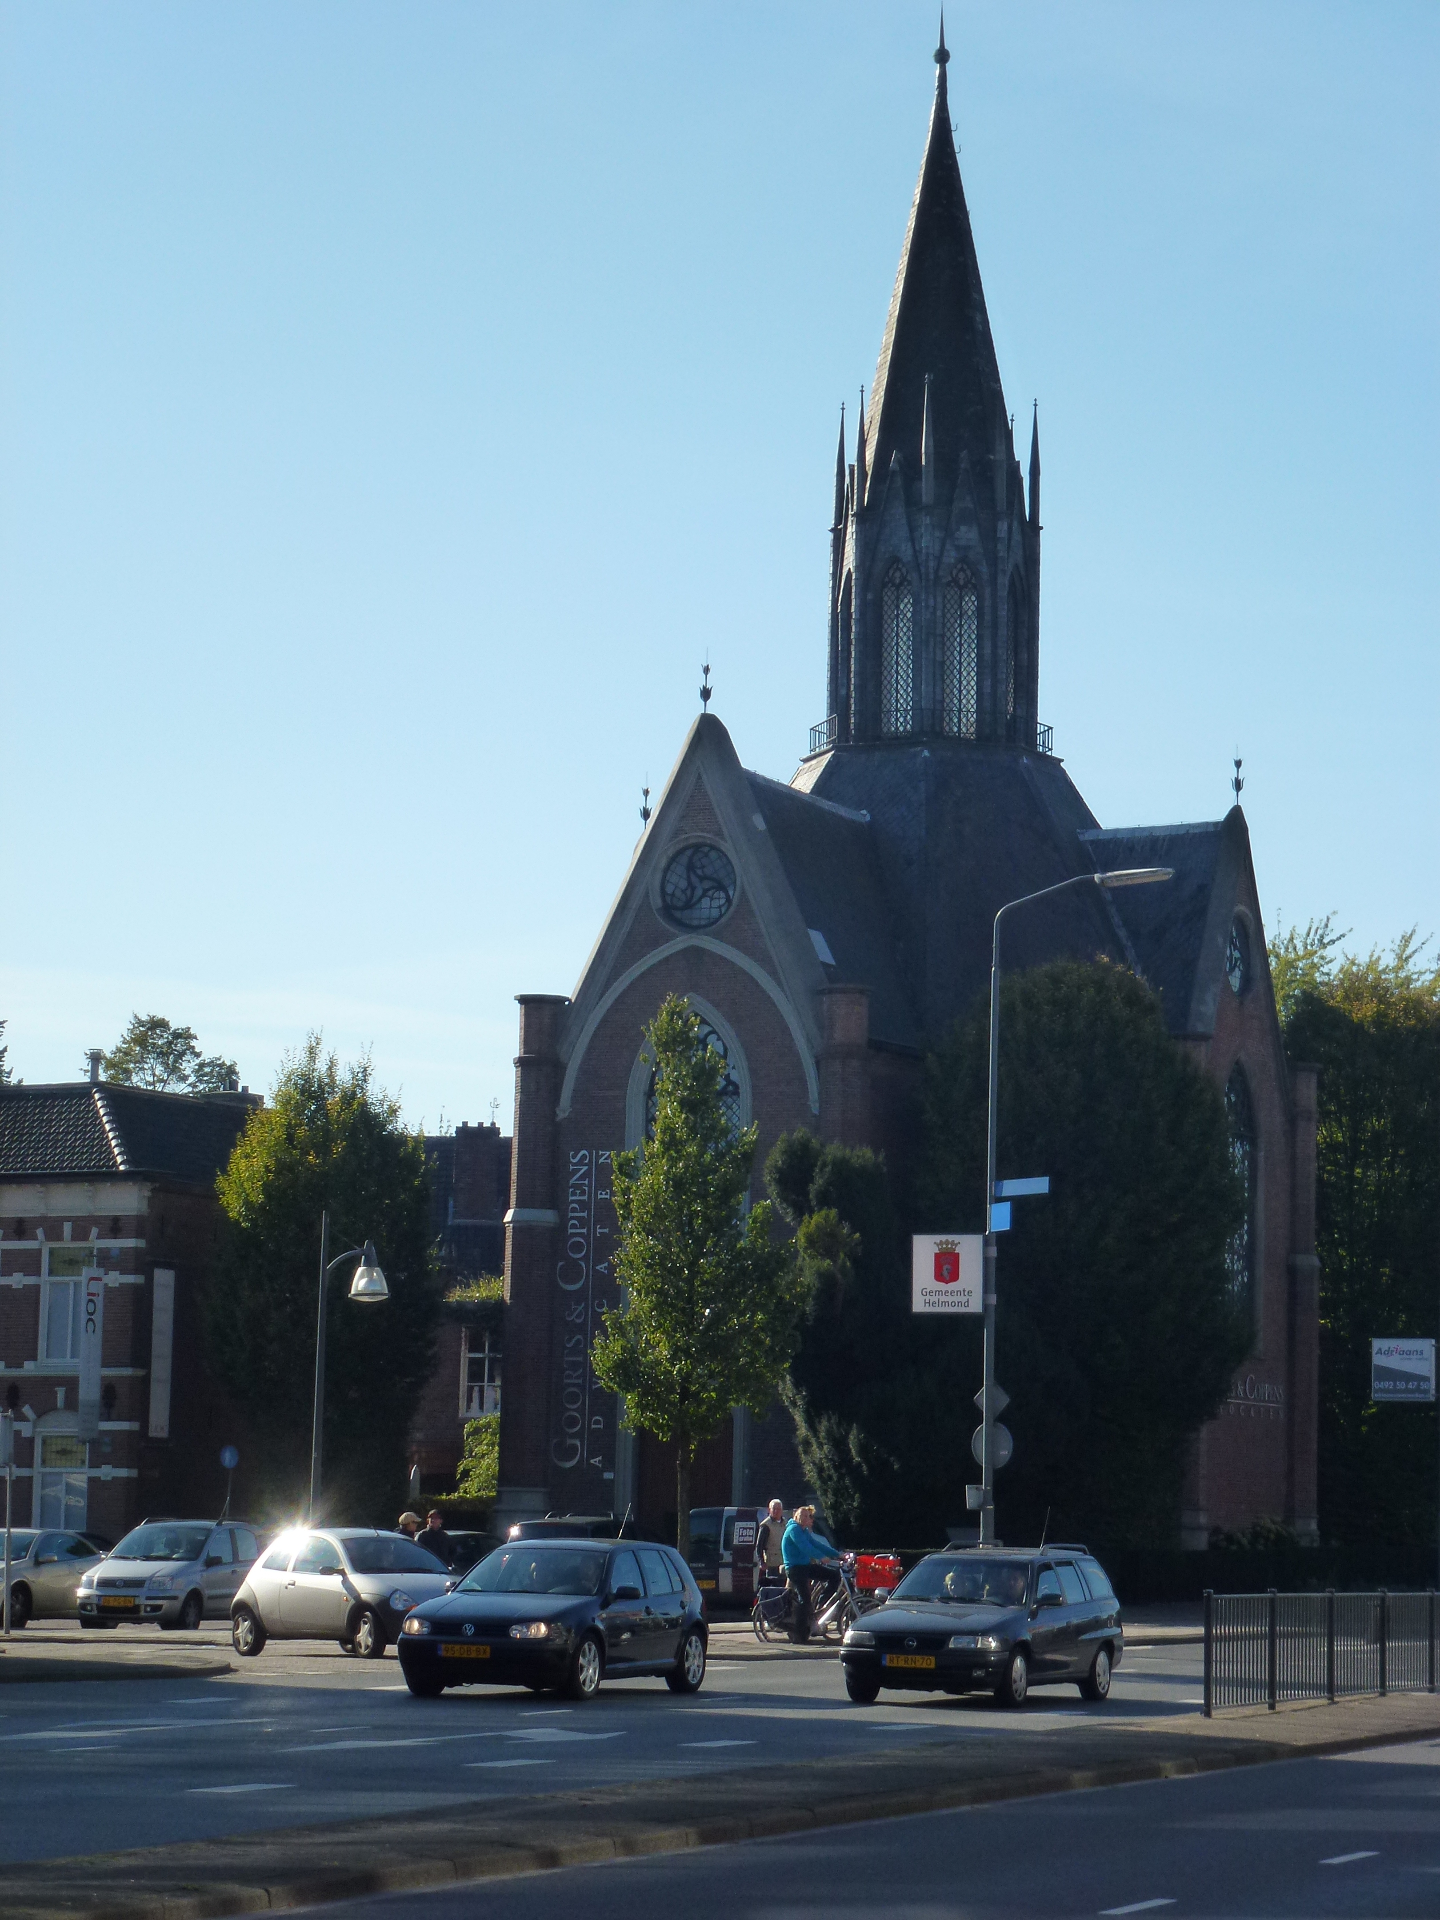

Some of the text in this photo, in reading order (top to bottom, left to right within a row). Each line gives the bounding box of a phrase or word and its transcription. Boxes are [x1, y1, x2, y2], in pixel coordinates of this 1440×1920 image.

[556, 1149, 590, 1291] COPPENS
[920, 1287, 973, 1297] Gemeente
[923, 1298, 970, 1308] Helmond
[565, 1301, 586, 1324] &
[590, 1150, 612, 1468] ADVCATEN
[1374, 1345, 1424, 1356] Adriaans
[1374, 1381, 1394, 1389] 0492
[1396, 1381, 1406, 1389] 50
[1407, 1381, 1418, 1389] 47
[889, 1655, 932, 1666] RT-RN-70
